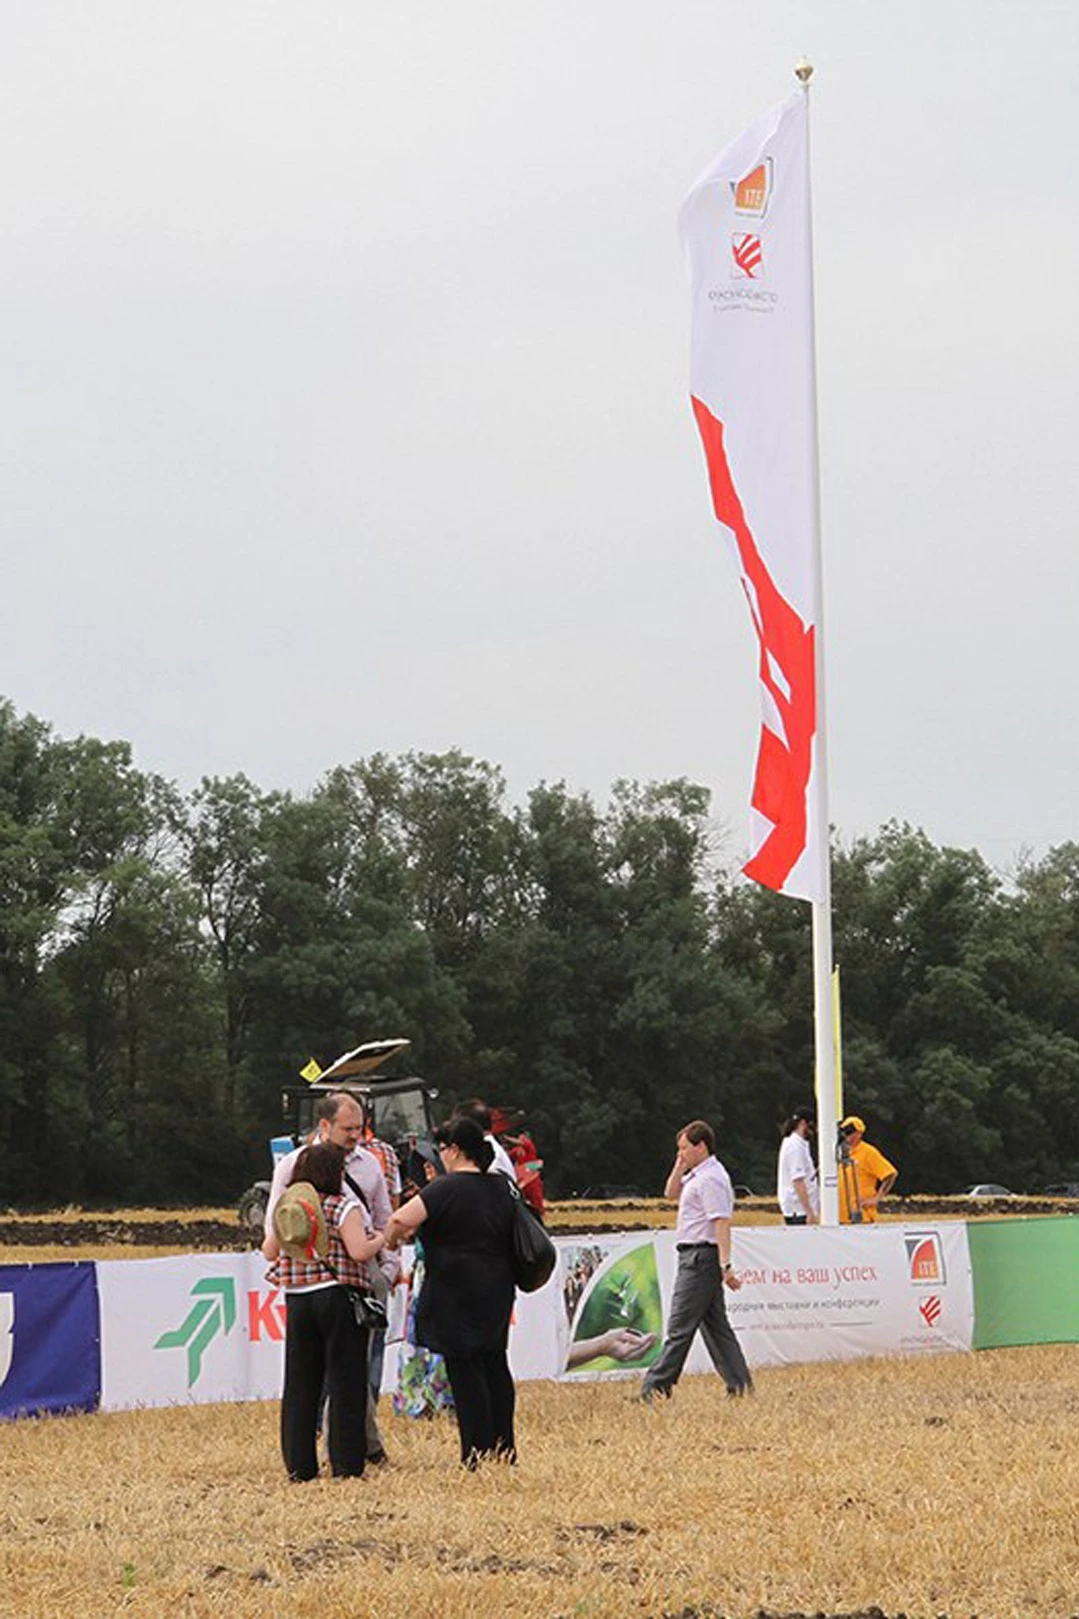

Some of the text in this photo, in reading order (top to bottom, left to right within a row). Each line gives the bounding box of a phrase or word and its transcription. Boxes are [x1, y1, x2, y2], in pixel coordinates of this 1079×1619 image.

[772, 1268, 792, 1285] на
[796, 1267, 830, 1284] ваш
[832, 1265, 878, 1290] успех
